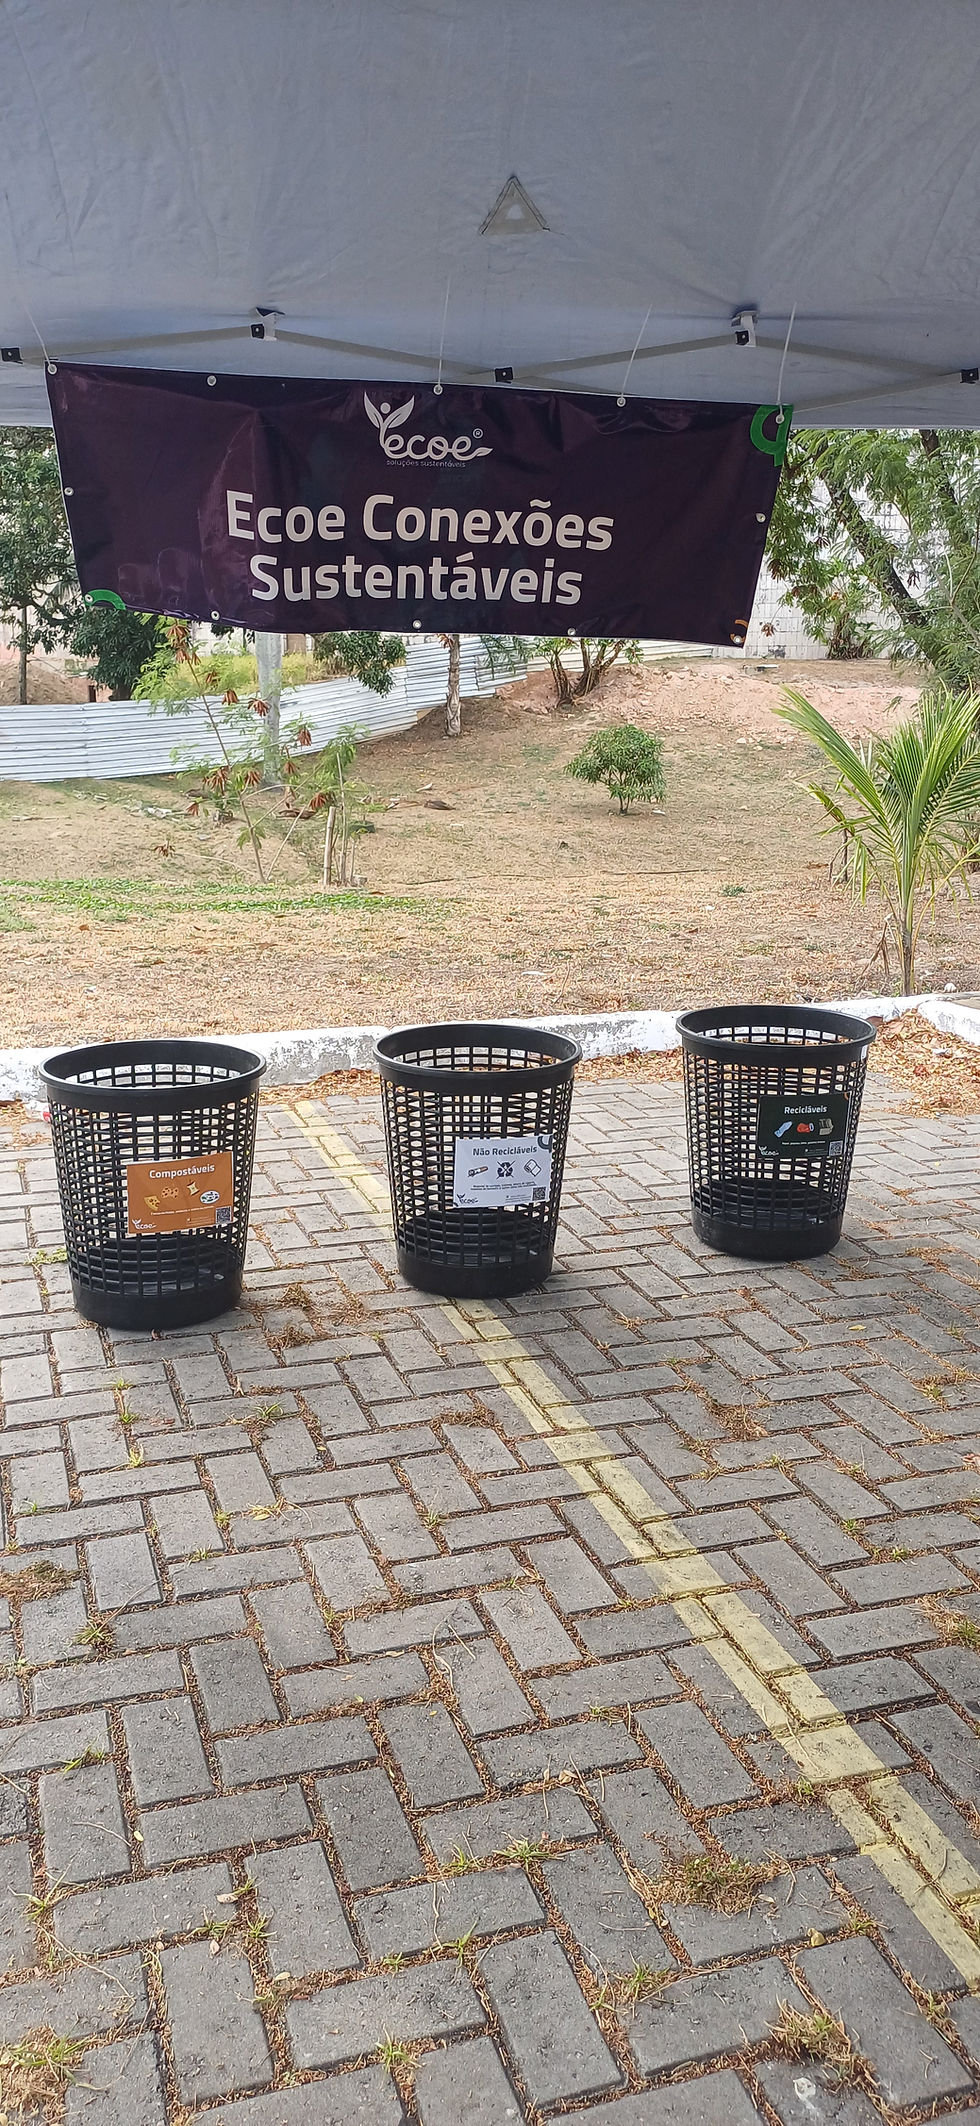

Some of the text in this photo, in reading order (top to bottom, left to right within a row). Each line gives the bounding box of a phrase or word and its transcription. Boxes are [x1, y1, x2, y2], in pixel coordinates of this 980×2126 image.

[386, 459, 466, 468] soluções sustentáveis
[226, 489, 615, 551] Ecoe Conexões
[249, 551, 583, 606] Sustentáveis
[784, 1105, 828, 1115] Recicláveis
[472, 1146, 538, 1156] Não Recicláveis
[149, 1163, 215, 1179] Compostáveis
